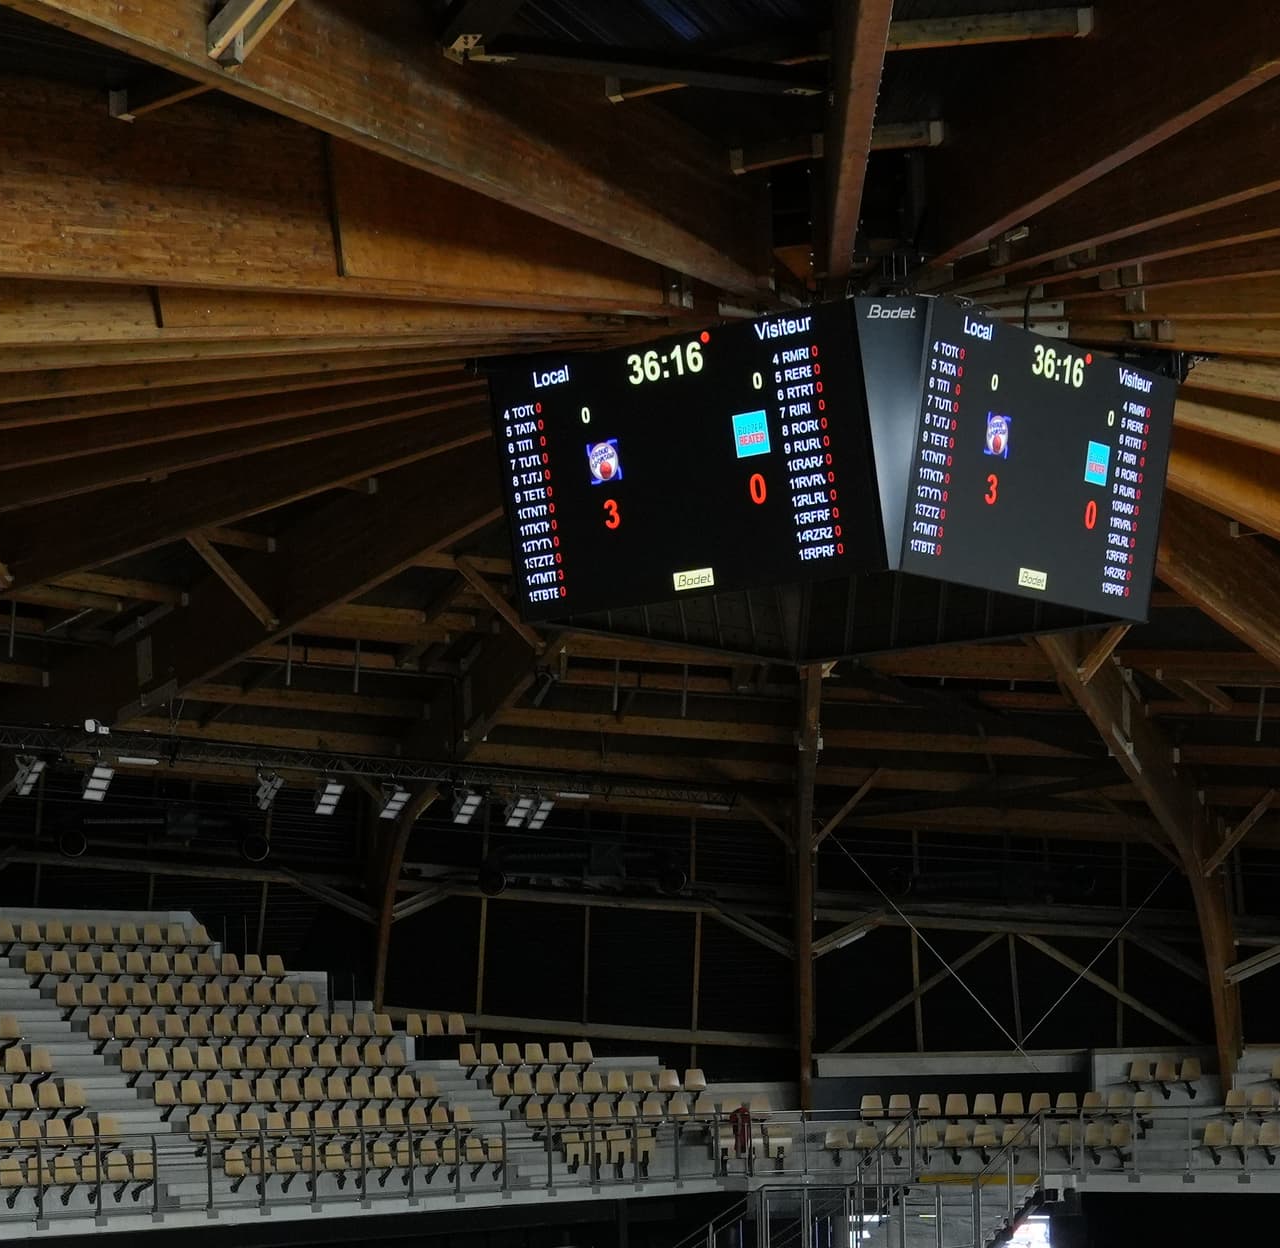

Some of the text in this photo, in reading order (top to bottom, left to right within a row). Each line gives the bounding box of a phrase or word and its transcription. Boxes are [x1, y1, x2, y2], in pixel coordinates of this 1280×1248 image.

[867, 304, 916, 319] Bodet
[754, 316, 811, 340] Visiteur
[964, 316, 993, 341] Local
[773, 354, 779, 365] 4
[812, 345, 818, 357] 0
[960, 348, 965, 359] 0
[627, 341, 704, 385] 36:16
[1032, 344, 1085, 388] 36:16
[533, 365, 569, 388] Local
[775, 372, 781, 383] 5
[814, 364, 820, 374] 0
[958, 367, 963, 376] 0
[753, 372, 763, 390] 0
[991, 374, 999, 391] 0
[1119, 367, 1152, 393] Visiteur
[777, 390, 784, 400] 6
[817, 382, 823, 392] 0
[955, 384, 960, 395] 0
[504, 410, 509, 420] 4
[536, 403, 541, 413] 0
[779, 407, 785, 418] 7
[819, 400, 825, 410] 0
[953, 402, 958, 413] 0
[1146, 408, 1151, 418] 0
[581, 407, 590, 424] 0
[1108, 410, 1114, 426] 0
[506, 427, 512, 437] 5
[538, 419, 544, 430] 0
[782, 425, 788, 436] 8
[821, 417, 827, 429] 0
[951, 420, 956, 430] 0
[1144, 424, 1149, 434] 0
[508, 443, 514, 453] 6
[540, 436, 546, 446] 0
[784, 443, 791, 454] 9
[823, 436, 829, 446] 0
[949, 438, 954, 448] 0
[1142, 441, 1147, 451] 0
[510, 459, 516, 470] 7
[542, 453, 548, 464] 0
[826, 454, 832, 464] 0
[947, 456, 952, 466] 0
[1140, 457, 1145, 467] 0
[513, 476, 519, 486] 8
[545, 469, 550, 480] 0
[828, 472, 834, 482] 0
[945, 473, 950, 484] 0
[1138, 473, 1143, 483] 0
[515, 493, 520, 503] 9
[547, 486, 552, 496] 0
[749, 473, 767, 505] 0
[830, 489, 836, 500] 0
[985, 474, 1000, 505] 3
[1136, 489, 1141, 499] 0
[943, 491, 948, 502] 0
[549, 503, 555, 513] 0
[833, 507, 839, 518] 0
[604, 499, 620, 529] 3
[941, 509, 946, 519] 0
[1084, 500, 1097, 529] 0
[551, 520, 557, 530] 0
[835, 525, 841, 536] 0
[938, 527, 943, 538] 3
[554, 536, 559, 547] 0
[837, 543, 843, 554] 0
[936, 544, 941, 555] 0
[556, 553, 561, 563] 0
[558, 570, 564, 580] 3
[678, 573, 711, 587] Bodet
[560, 587, 566, 597] 0
